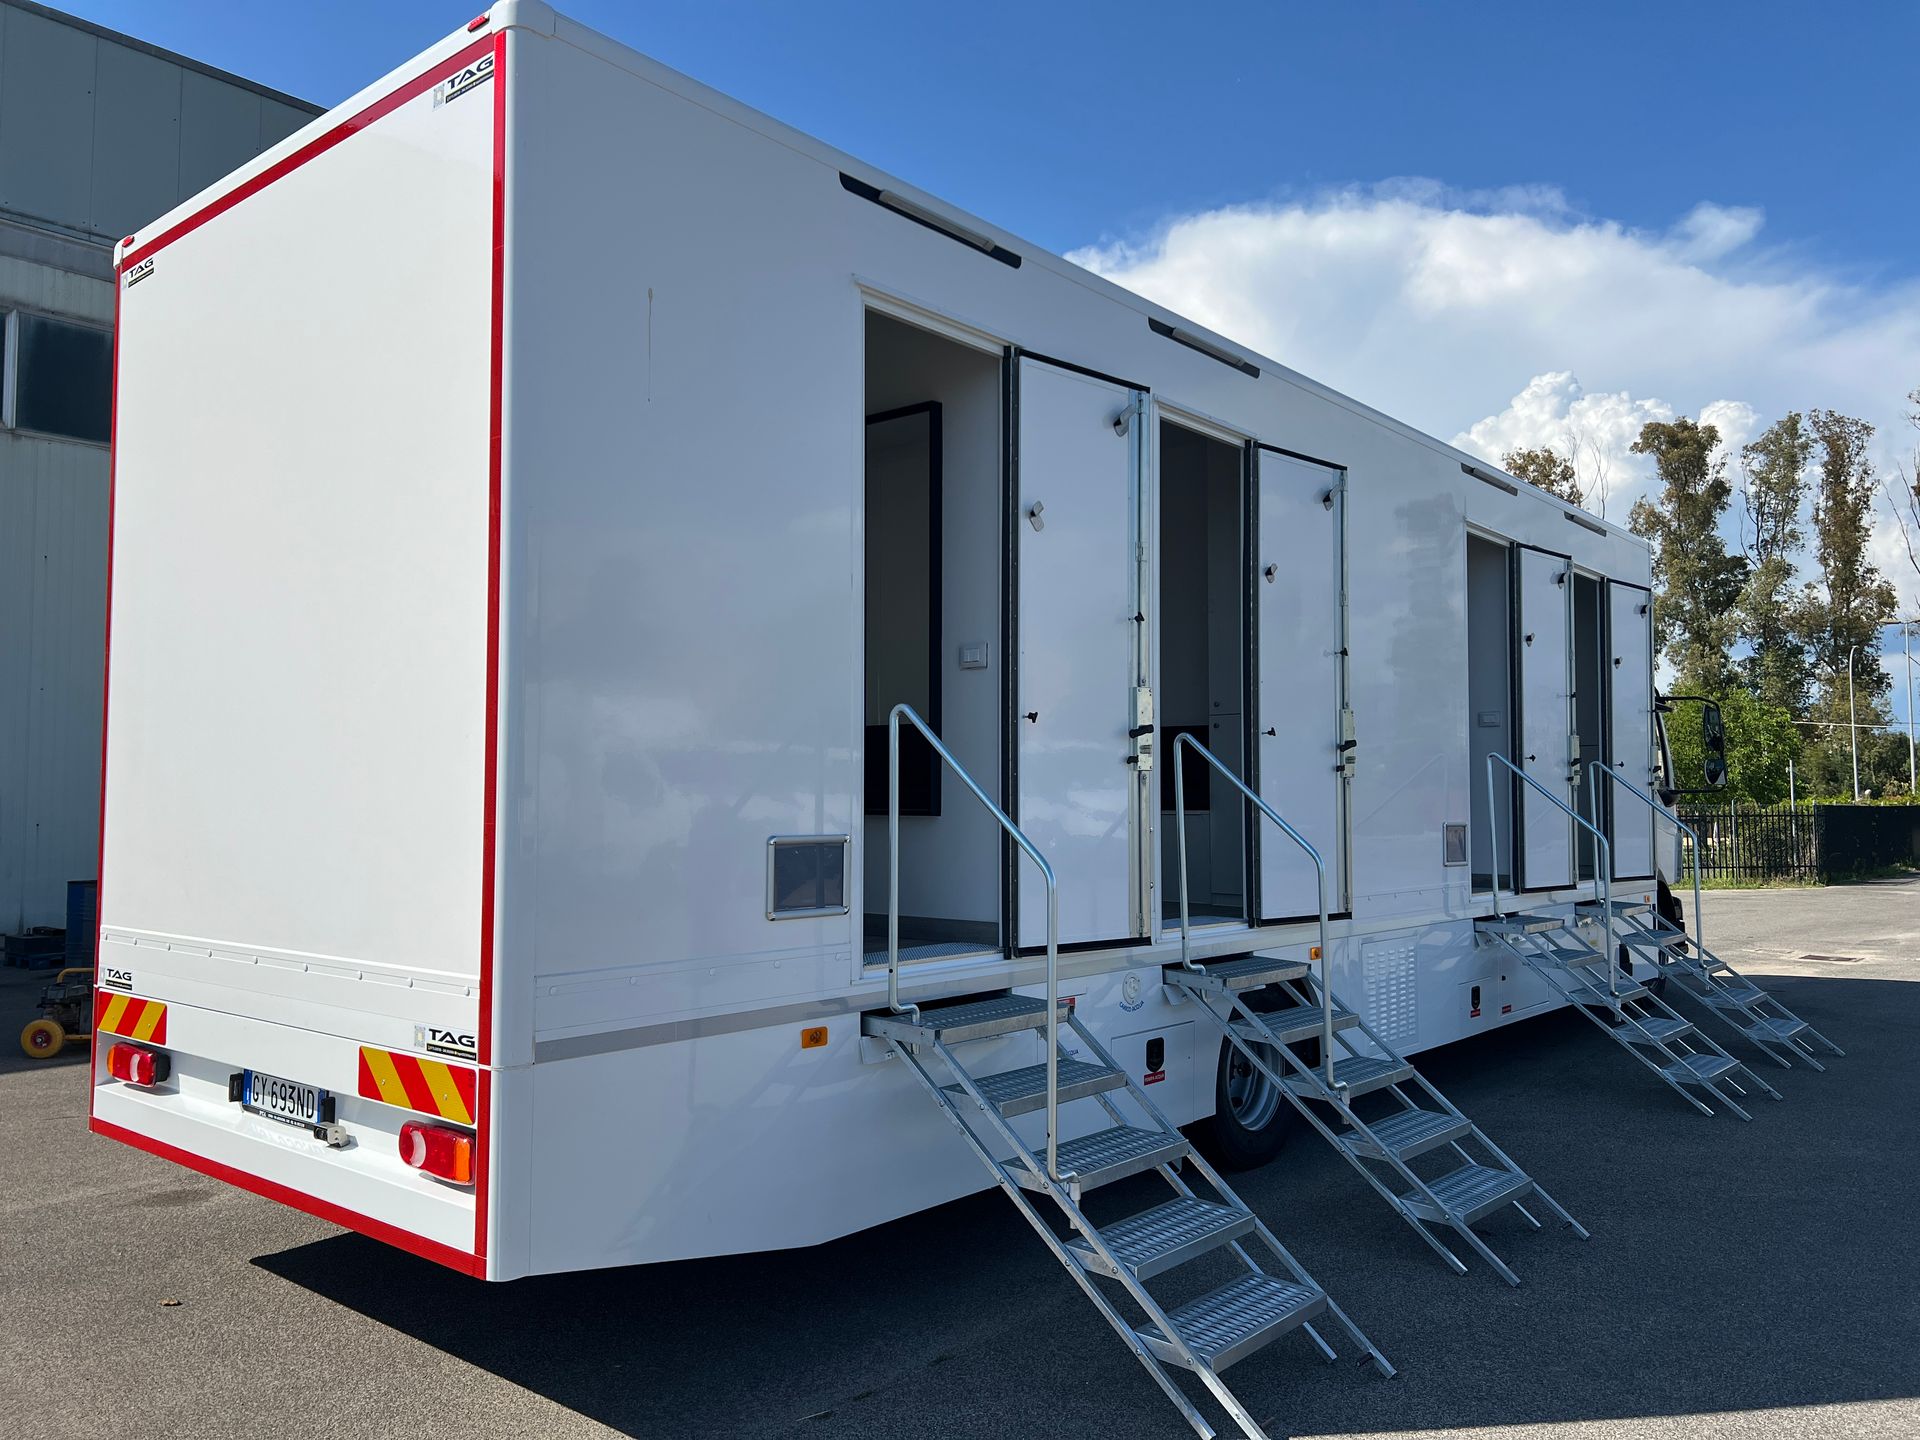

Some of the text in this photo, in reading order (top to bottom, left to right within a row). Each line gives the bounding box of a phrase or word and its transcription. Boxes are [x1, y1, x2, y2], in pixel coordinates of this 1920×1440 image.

[447, 54, 494, 89] TAG
[129, 257, 154, 278] TAG
[106, 968, 132, 981] TAG
[428, 1028, 475, 1048] TAG
[270, 1081, 315, 1119] 693ND
